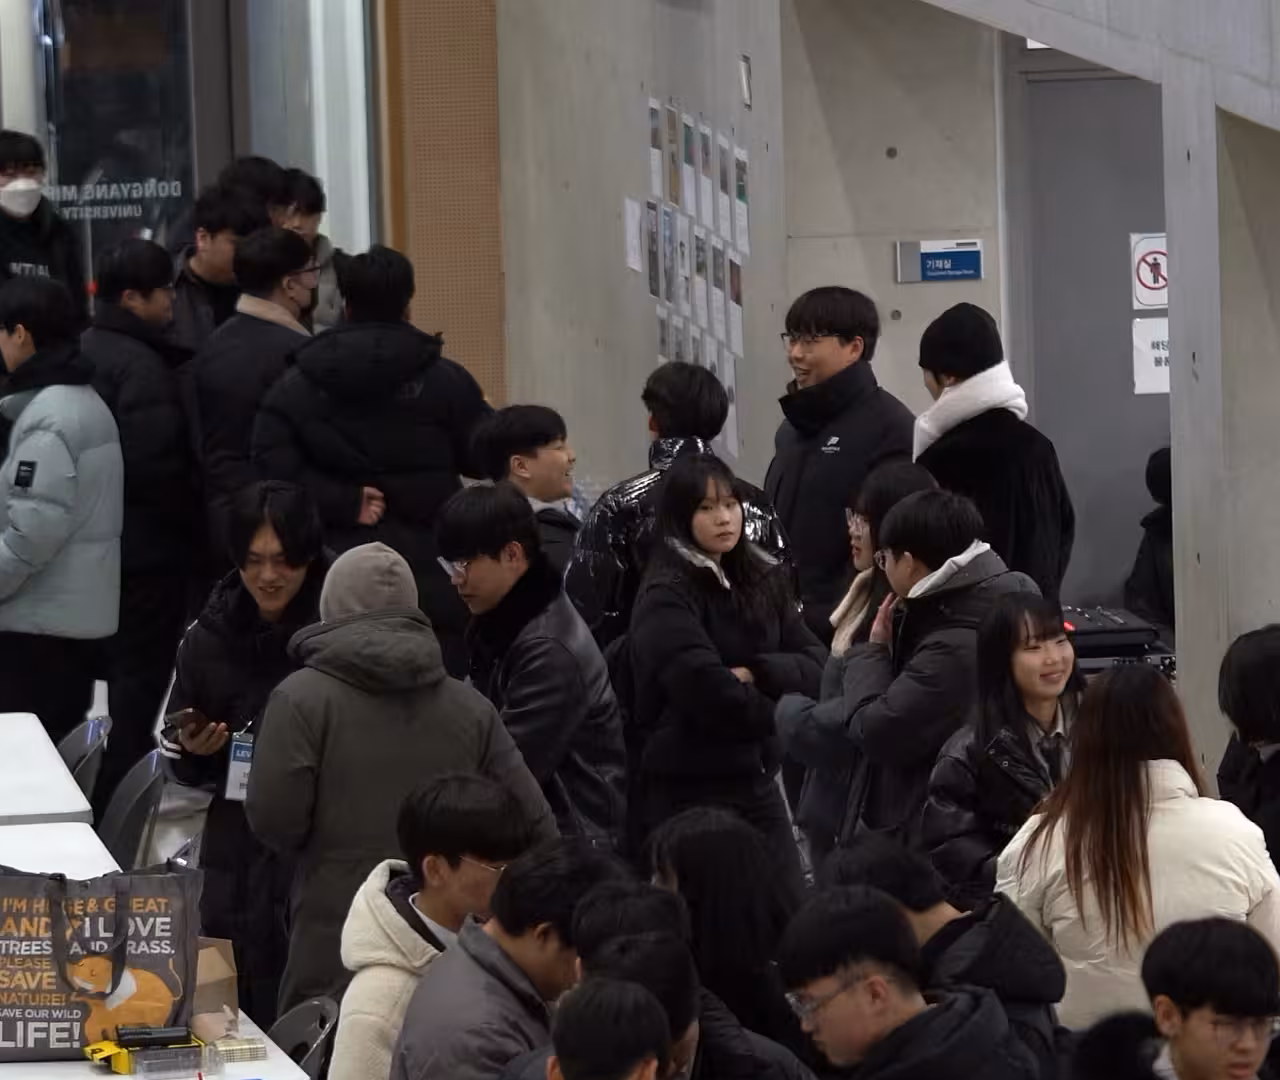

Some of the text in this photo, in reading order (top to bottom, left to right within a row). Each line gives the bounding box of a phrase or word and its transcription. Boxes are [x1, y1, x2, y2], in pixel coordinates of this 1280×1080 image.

[2, 898, 27, 913] I'M
[86, 898, 99, 912] &
[104, 897, 172, 914] GEAT.
[0, 916, 53, 937] AND
[125, 940, 176, 954] RASS.
[25, 1009, 49, 1018] OUR
[51, 1009, 82, 1019] WILD
